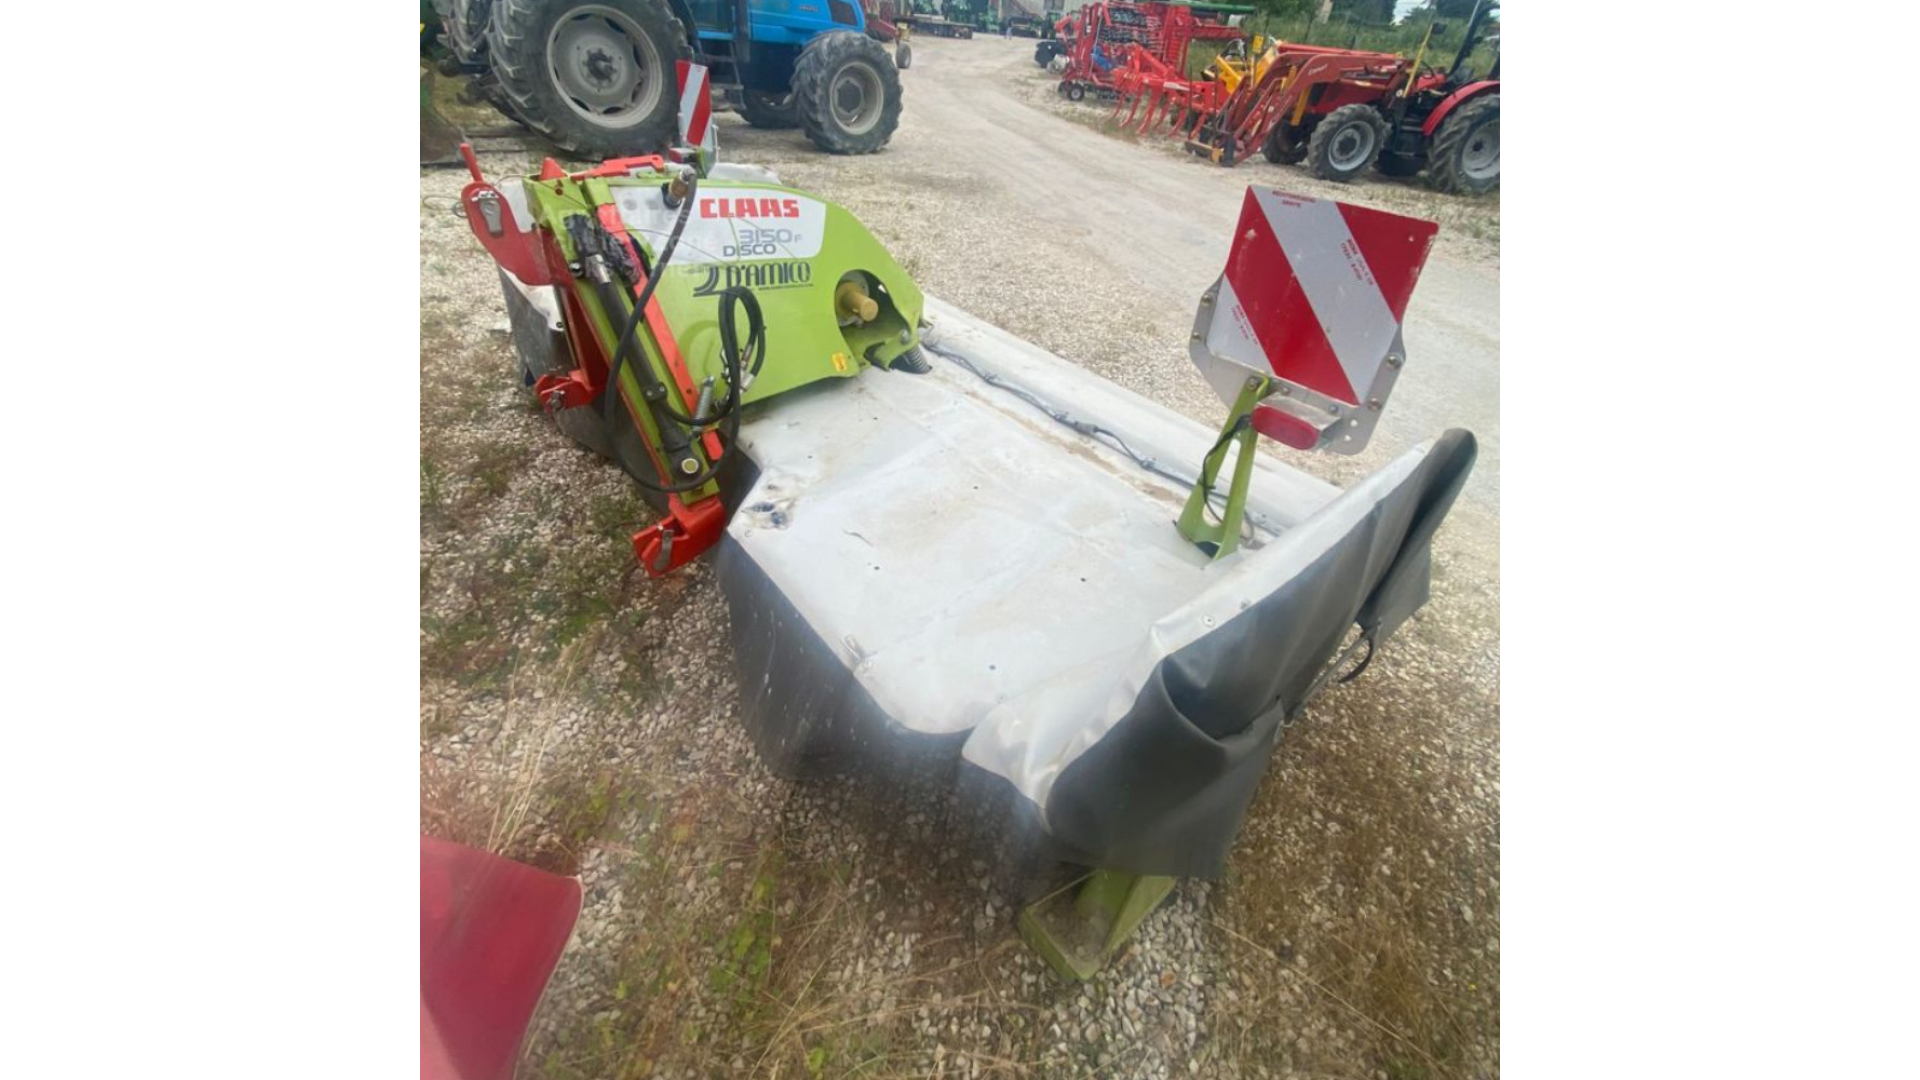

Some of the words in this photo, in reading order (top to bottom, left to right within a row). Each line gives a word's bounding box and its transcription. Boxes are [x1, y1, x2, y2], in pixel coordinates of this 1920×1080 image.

[699, 198, 800, 219] CLAAS
[738, 229, 793, 244] 3150
[723, 245, 776, 257] DISCO
